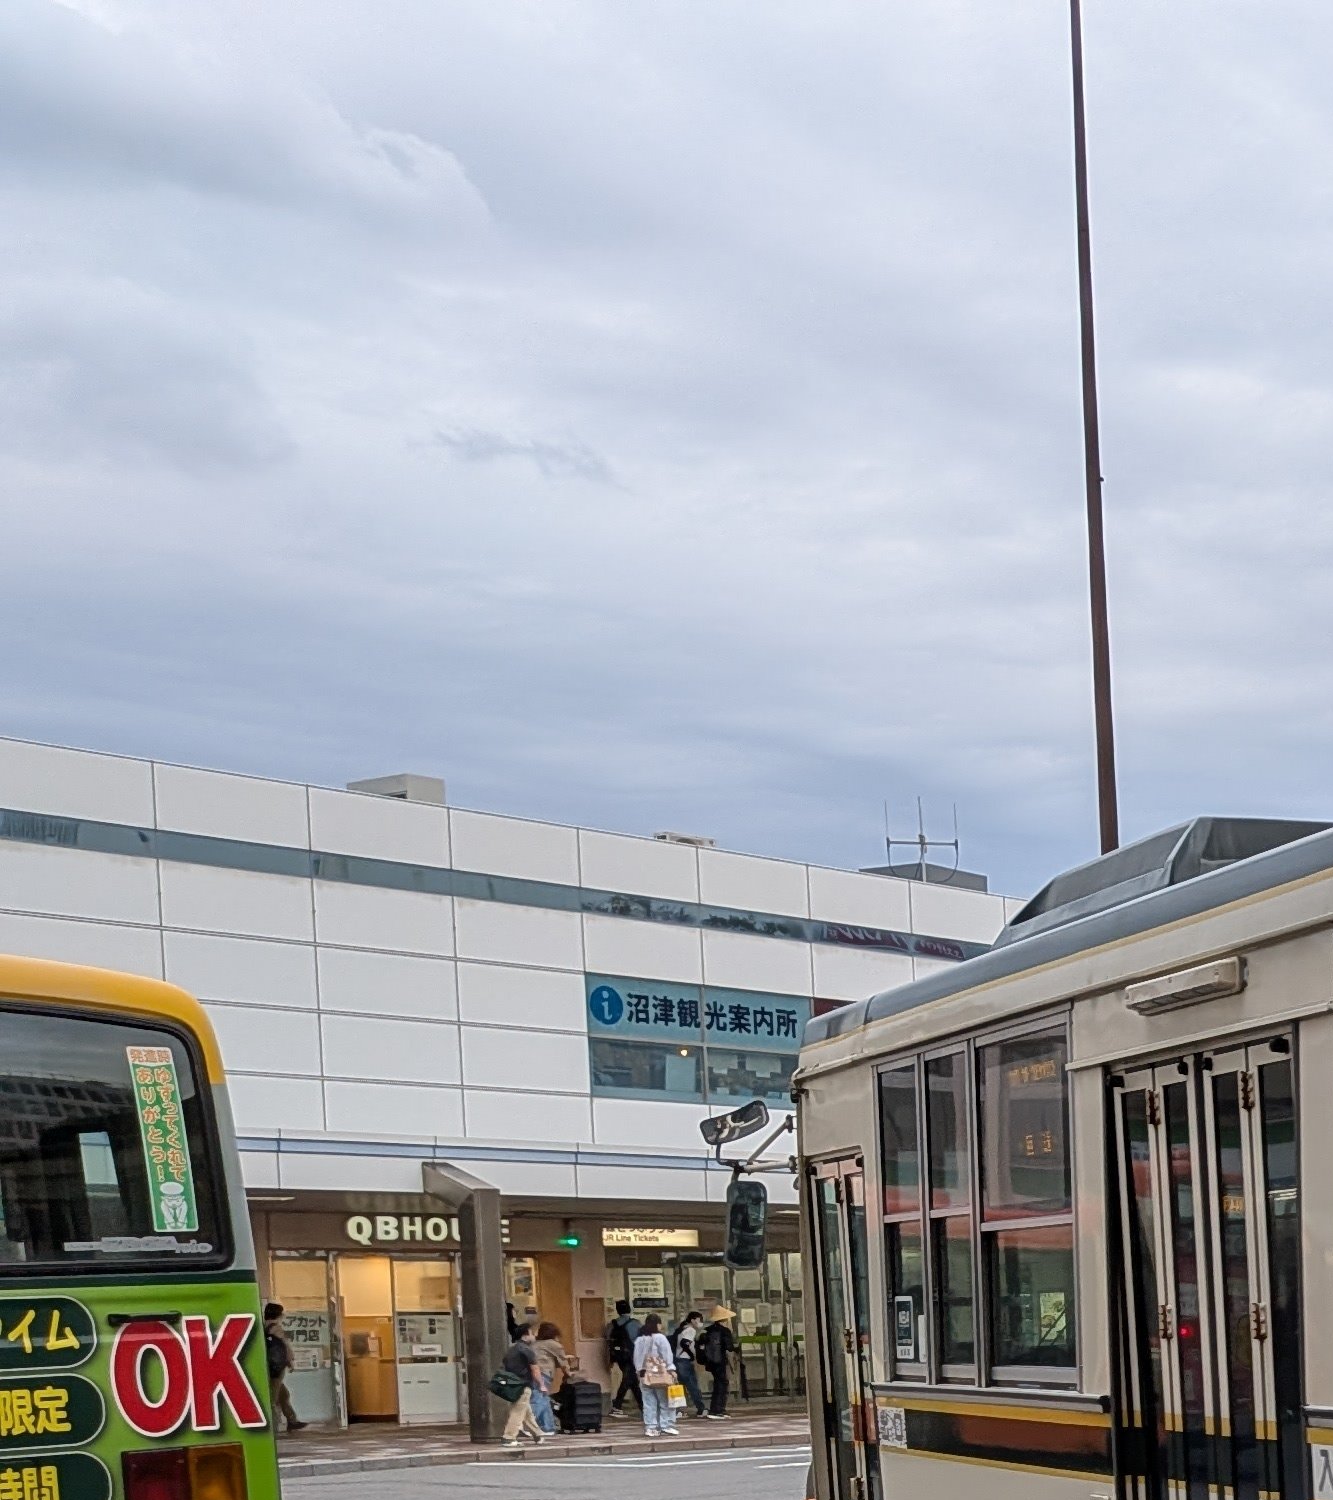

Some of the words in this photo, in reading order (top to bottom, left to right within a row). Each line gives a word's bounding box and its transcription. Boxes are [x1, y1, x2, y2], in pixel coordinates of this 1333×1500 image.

[625, 992, 798, 1039] 沼津観光案内所
[153, 1066, 186, 1183] ゆずってくれて
[346, 1215, 510, 1246] QBHO
[616, 1234, 632, 1242] Line
[634, 1235, 659, 1243] Tickets
[0, 1309, 80, 1354] イム
[109, 1314, 267, 1437] OK
